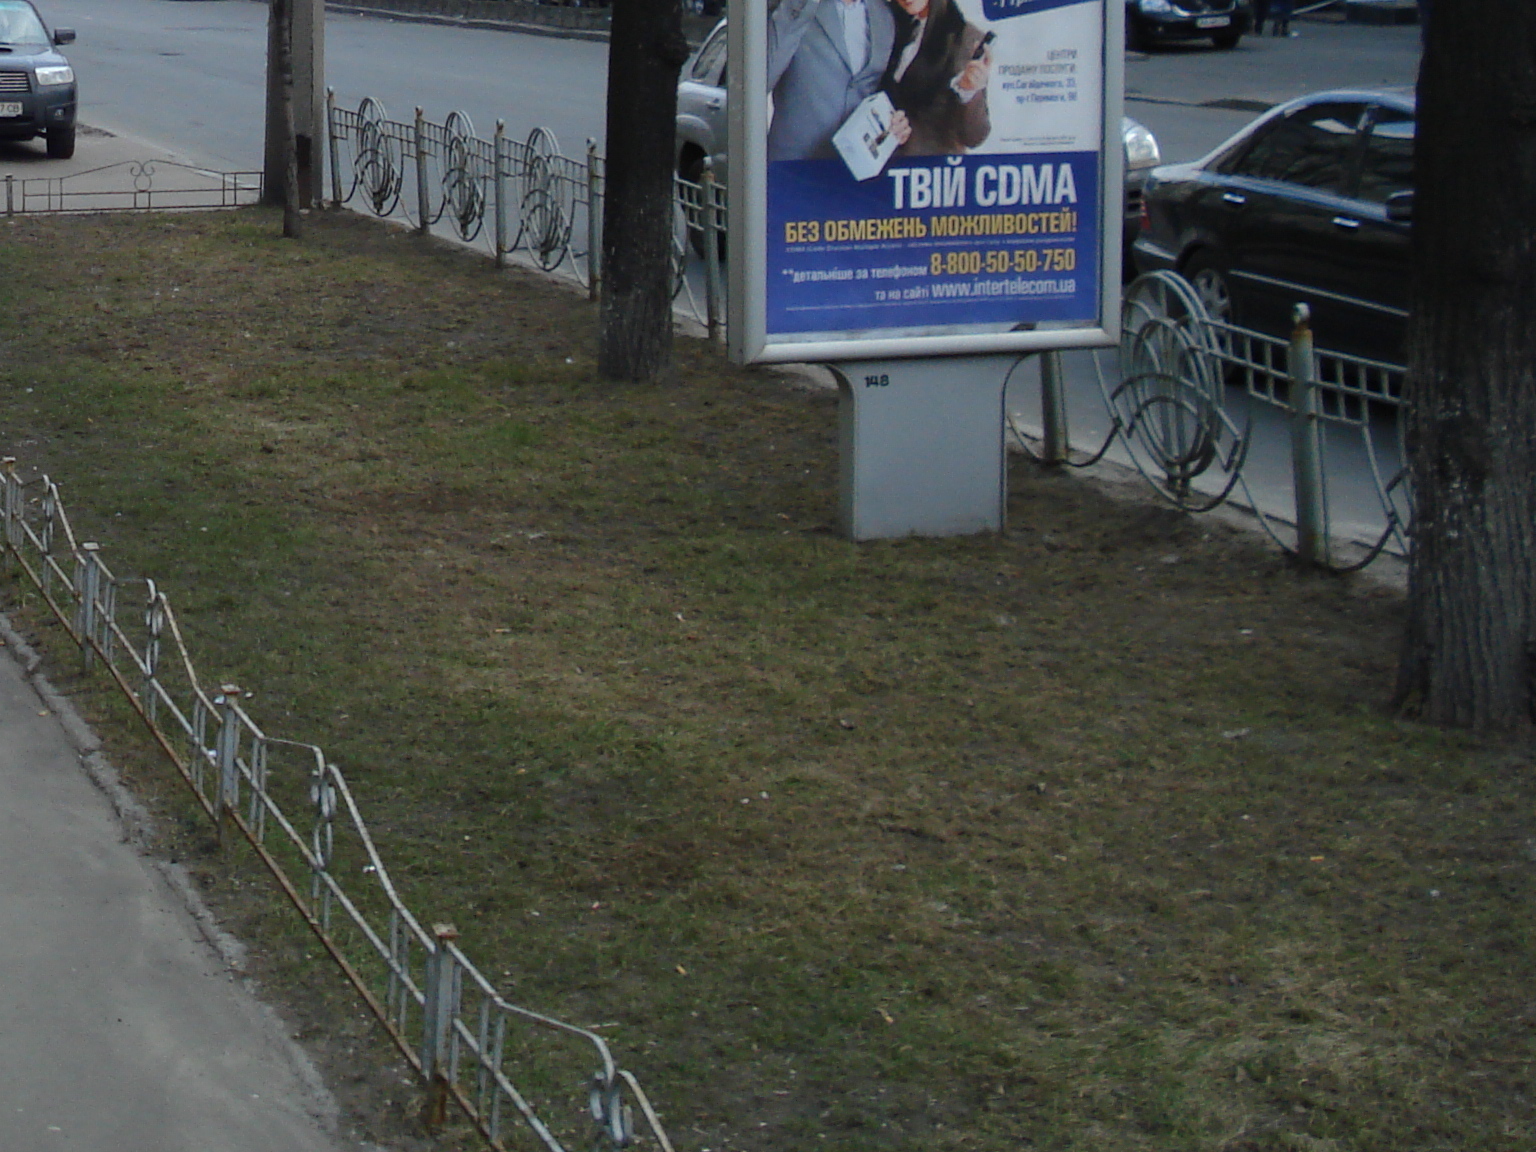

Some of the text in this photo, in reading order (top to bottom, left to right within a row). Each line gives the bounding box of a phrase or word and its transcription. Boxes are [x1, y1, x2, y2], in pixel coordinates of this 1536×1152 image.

[888, 156, 1077, 209] ТВІЙ CDMA
[785, 207, 1078, 243] БЕЗ ОБМЕЖЕНЬ МОЖЛИВОСТЕЙ!
[855, 268, 868, 279] за
[871, 265, 928, 280] телефоном
[930, 249, 1076, 275] 8-800-50-50-750
[875, 276, 1076, 300] та на сайті www.intertelecom.ua
[865, 375, 890, 387] 148
